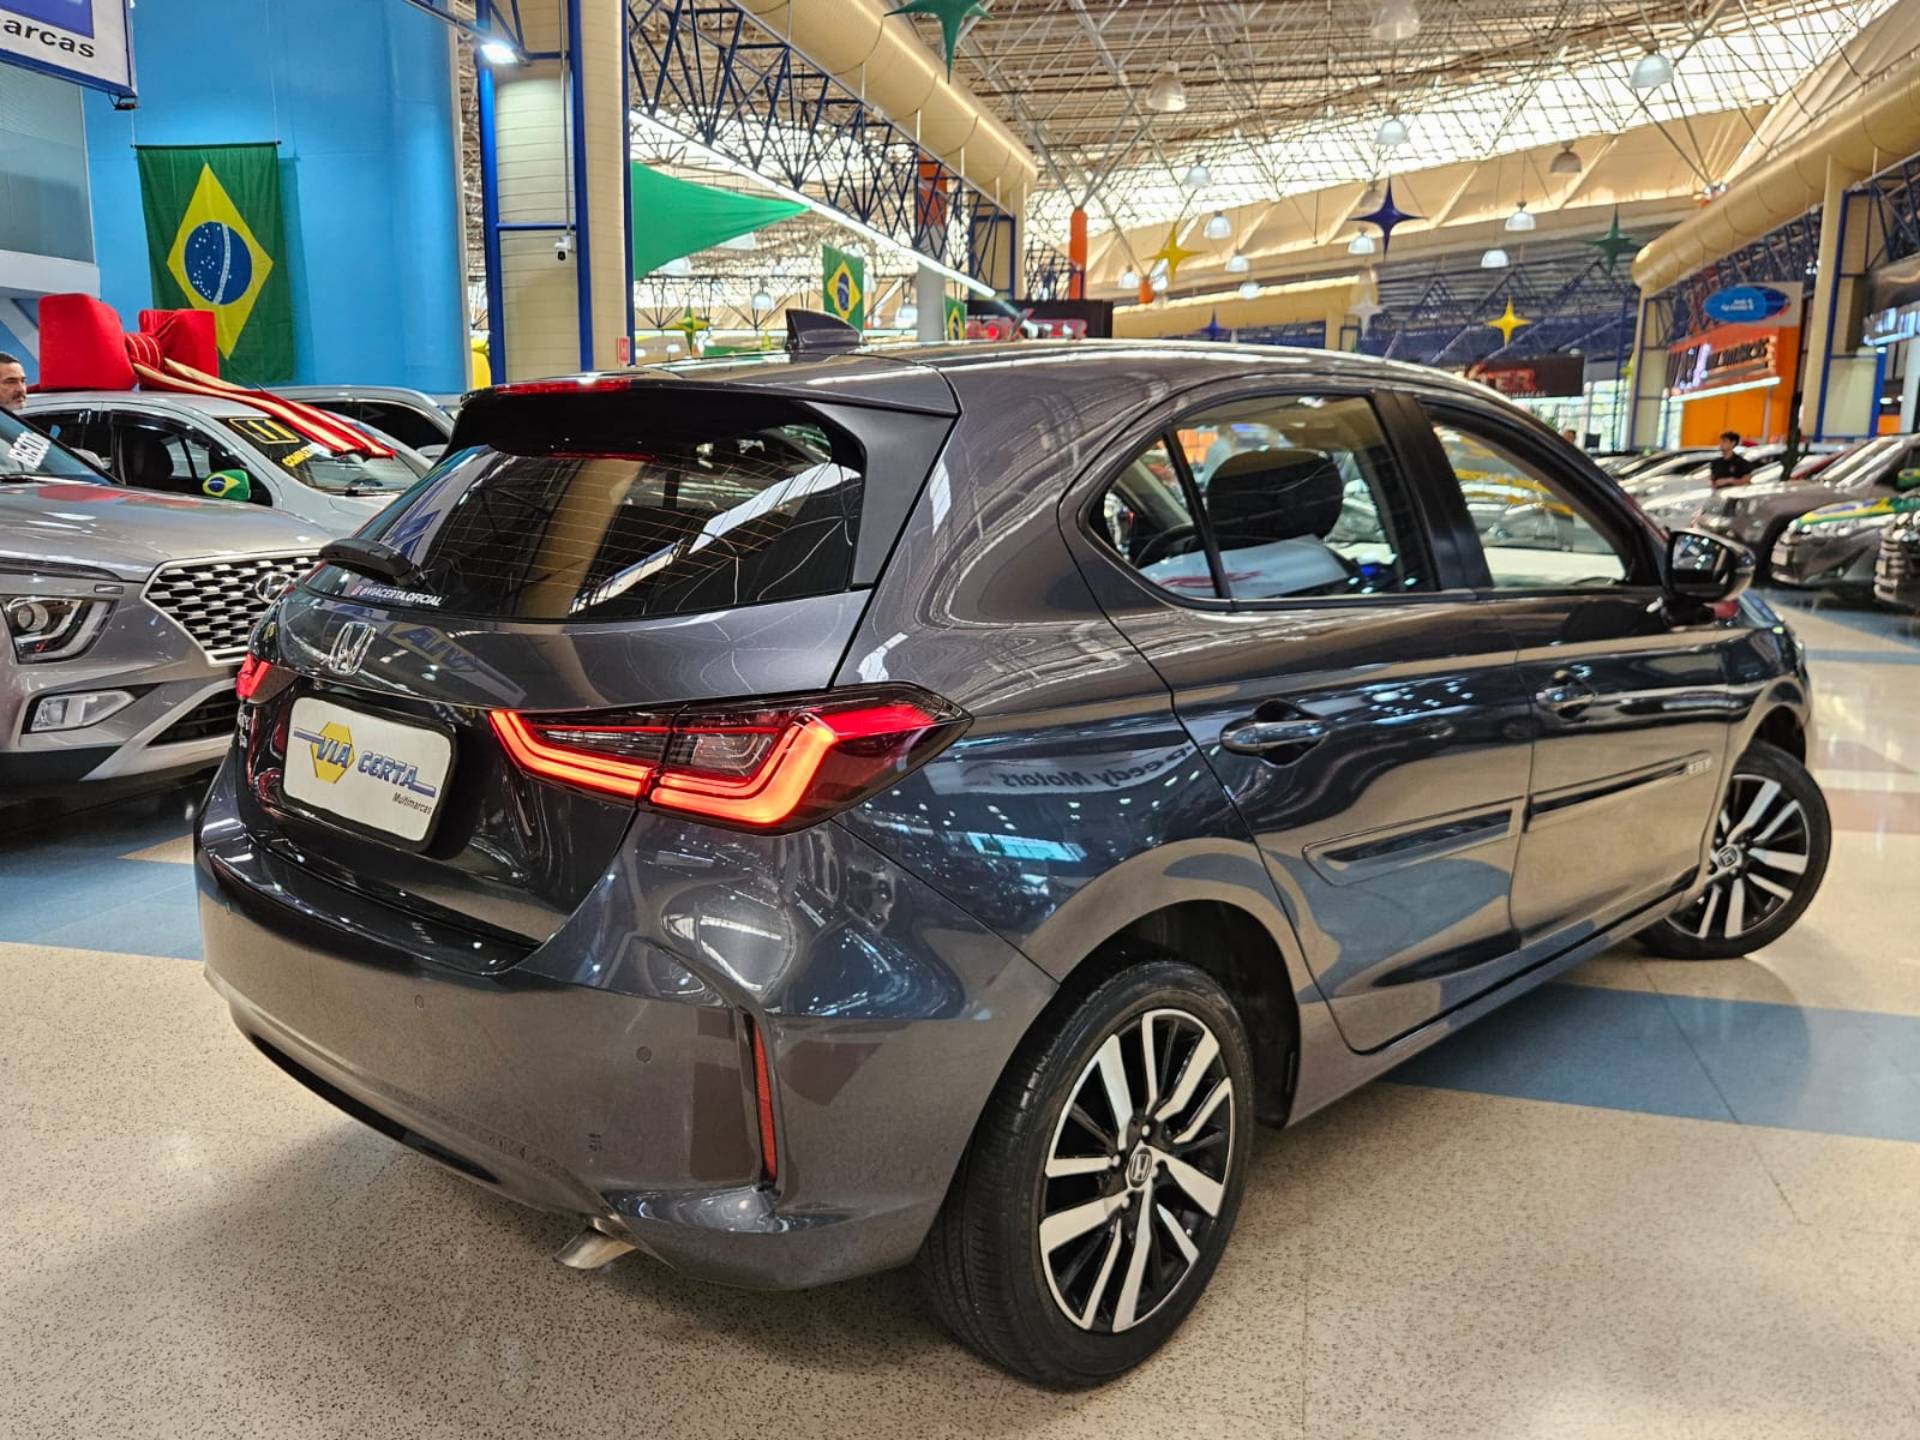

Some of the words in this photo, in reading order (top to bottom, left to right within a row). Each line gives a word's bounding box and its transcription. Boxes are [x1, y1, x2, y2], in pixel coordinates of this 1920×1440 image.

[0, 18, 95, 58] arcas
[316, 737, 353, 768] VIA
[357, 751, 418, 788] CERTA
[391, 791, 432, 815] Multimarcas
